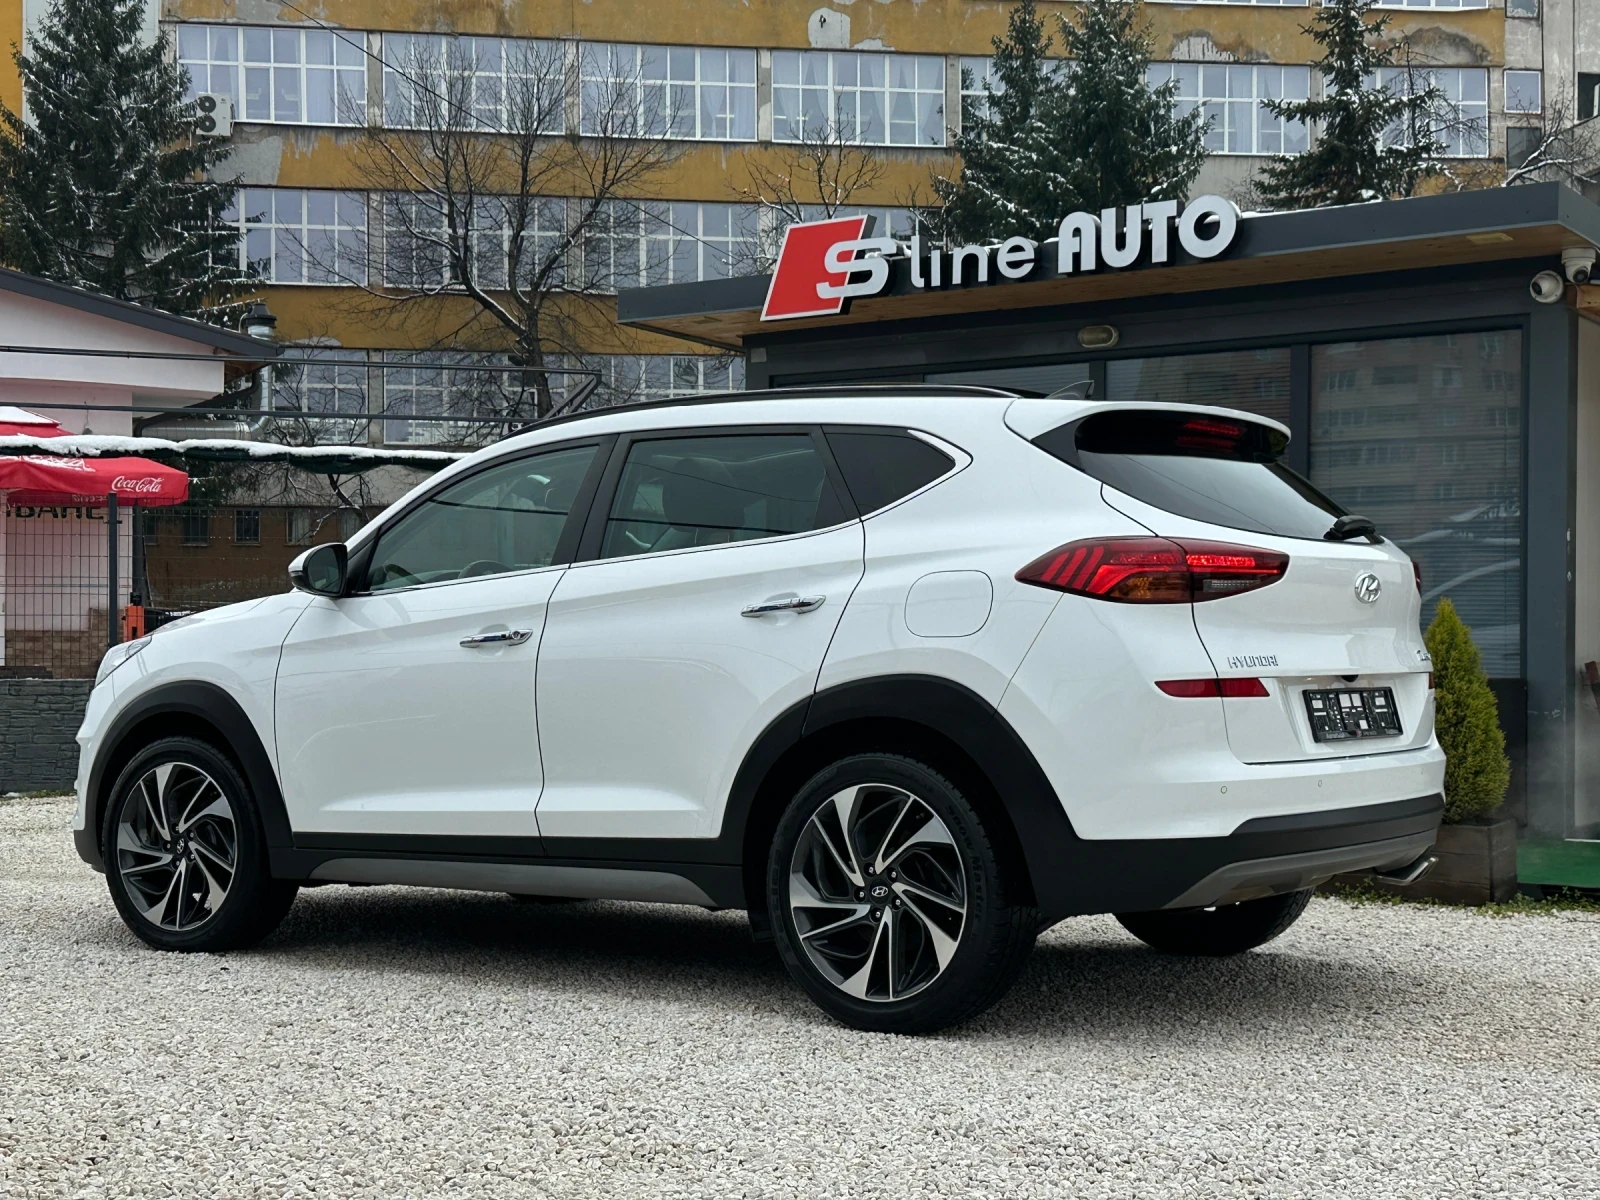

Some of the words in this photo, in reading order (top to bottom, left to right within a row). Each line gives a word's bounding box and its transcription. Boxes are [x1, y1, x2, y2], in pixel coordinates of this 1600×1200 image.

[910, 234, 1036, 289] line
[1057, 194, 1243, 275] AUTO
[111, 475, 164, 493] Coca-Cola
[1226, 654, 1279, 669] HYUNDAI
